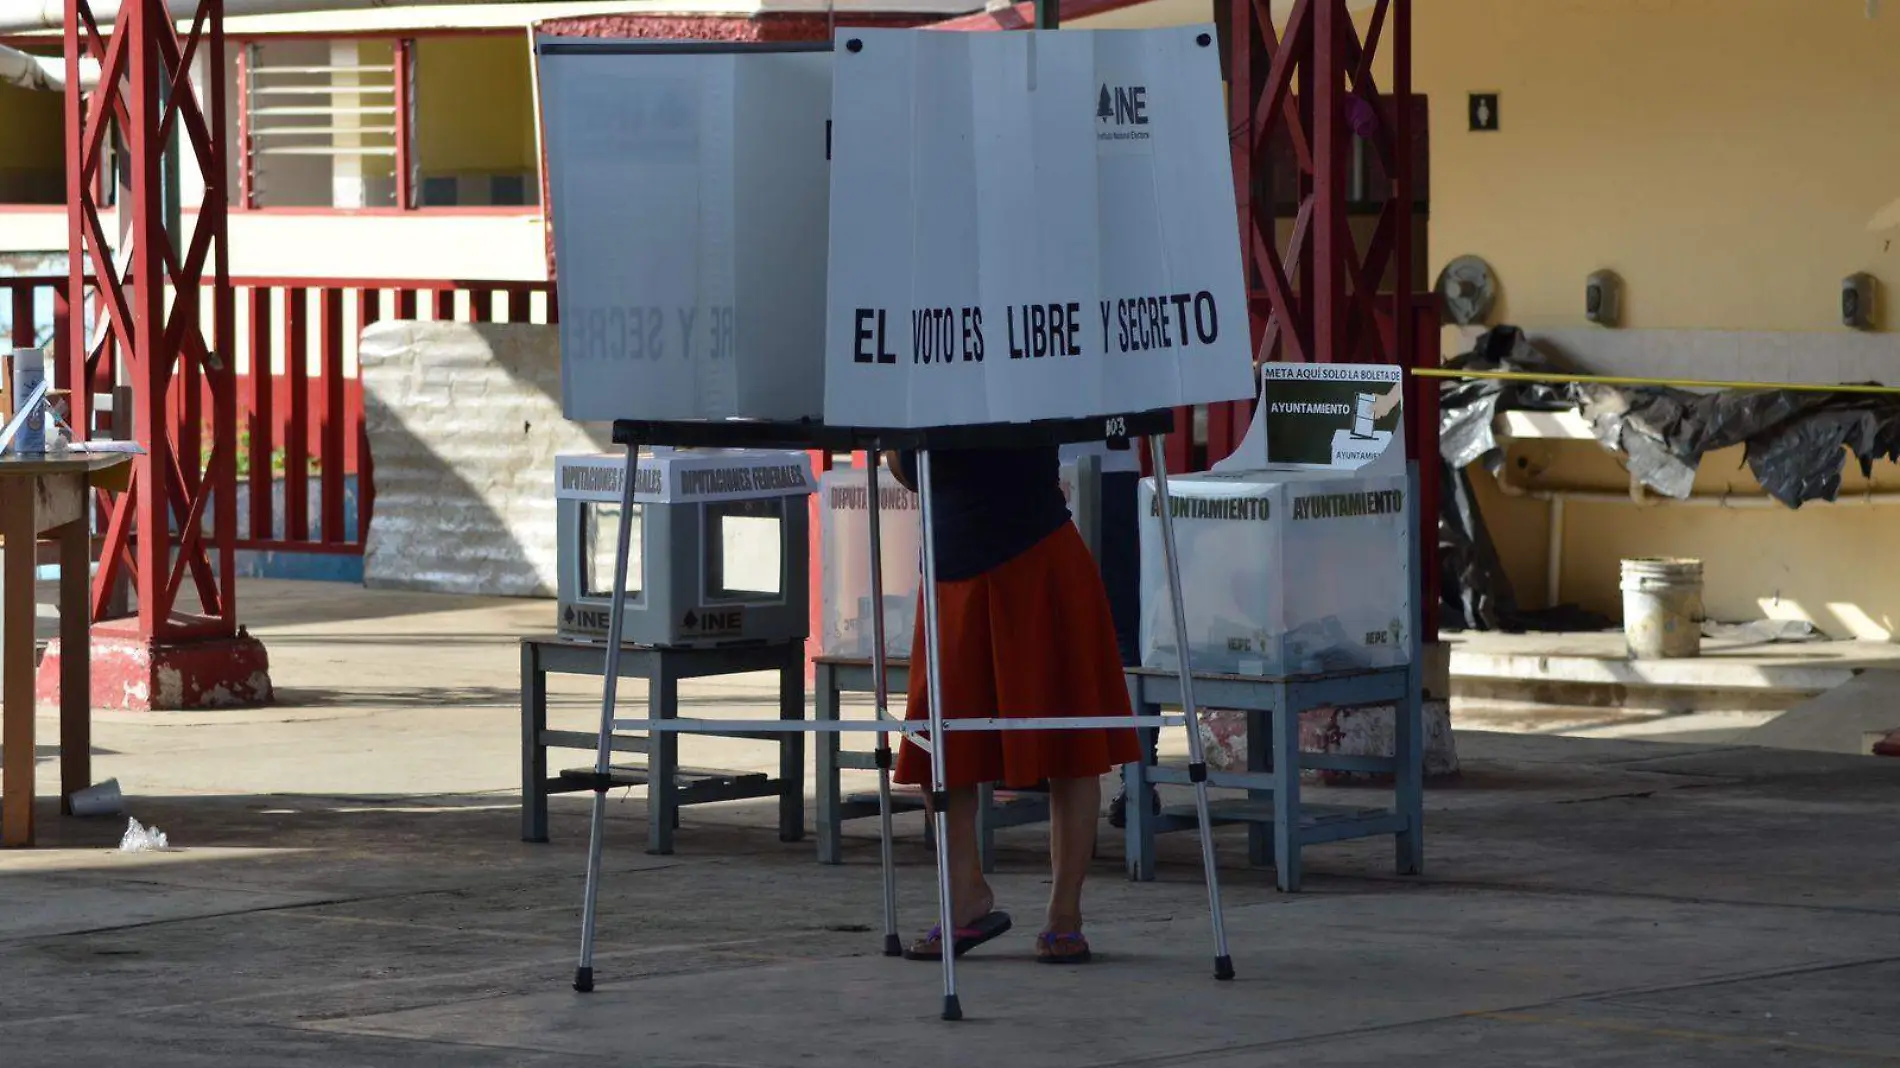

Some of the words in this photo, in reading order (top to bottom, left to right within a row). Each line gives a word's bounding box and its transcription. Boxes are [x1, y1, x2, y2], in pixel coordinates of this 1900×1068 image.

[1114, 86, 1149, 124] INE
[854, 309, 896, 363] EL
[912, 307, 954, 364] VOTO
[962, 306, 984, 362] ES
[1007, 302, 1081, 360] LIBRE
[1100, 300, 1110, 353] Y
[1118, 291, 1218, 352] SECRETO
[1265, 368, 1293, 379] META
[1296, 367, 1320, 379] AQUÍ
[1322, 368, 1348, 380] SOLO
[1349, 371, 1359, 379] LA
[1361, 370, 1389, 380] BOLETA
[1391, 371, 1400, 381] DE
[1271, 402, 1350, 415] AYUNTAMIENTO
[1150, 495, 1270, 521] AUNTAMIENTO
[1293, 489, 1402, 520] AYUNTAMIENTO
[701, 612, 742, 631] INE
